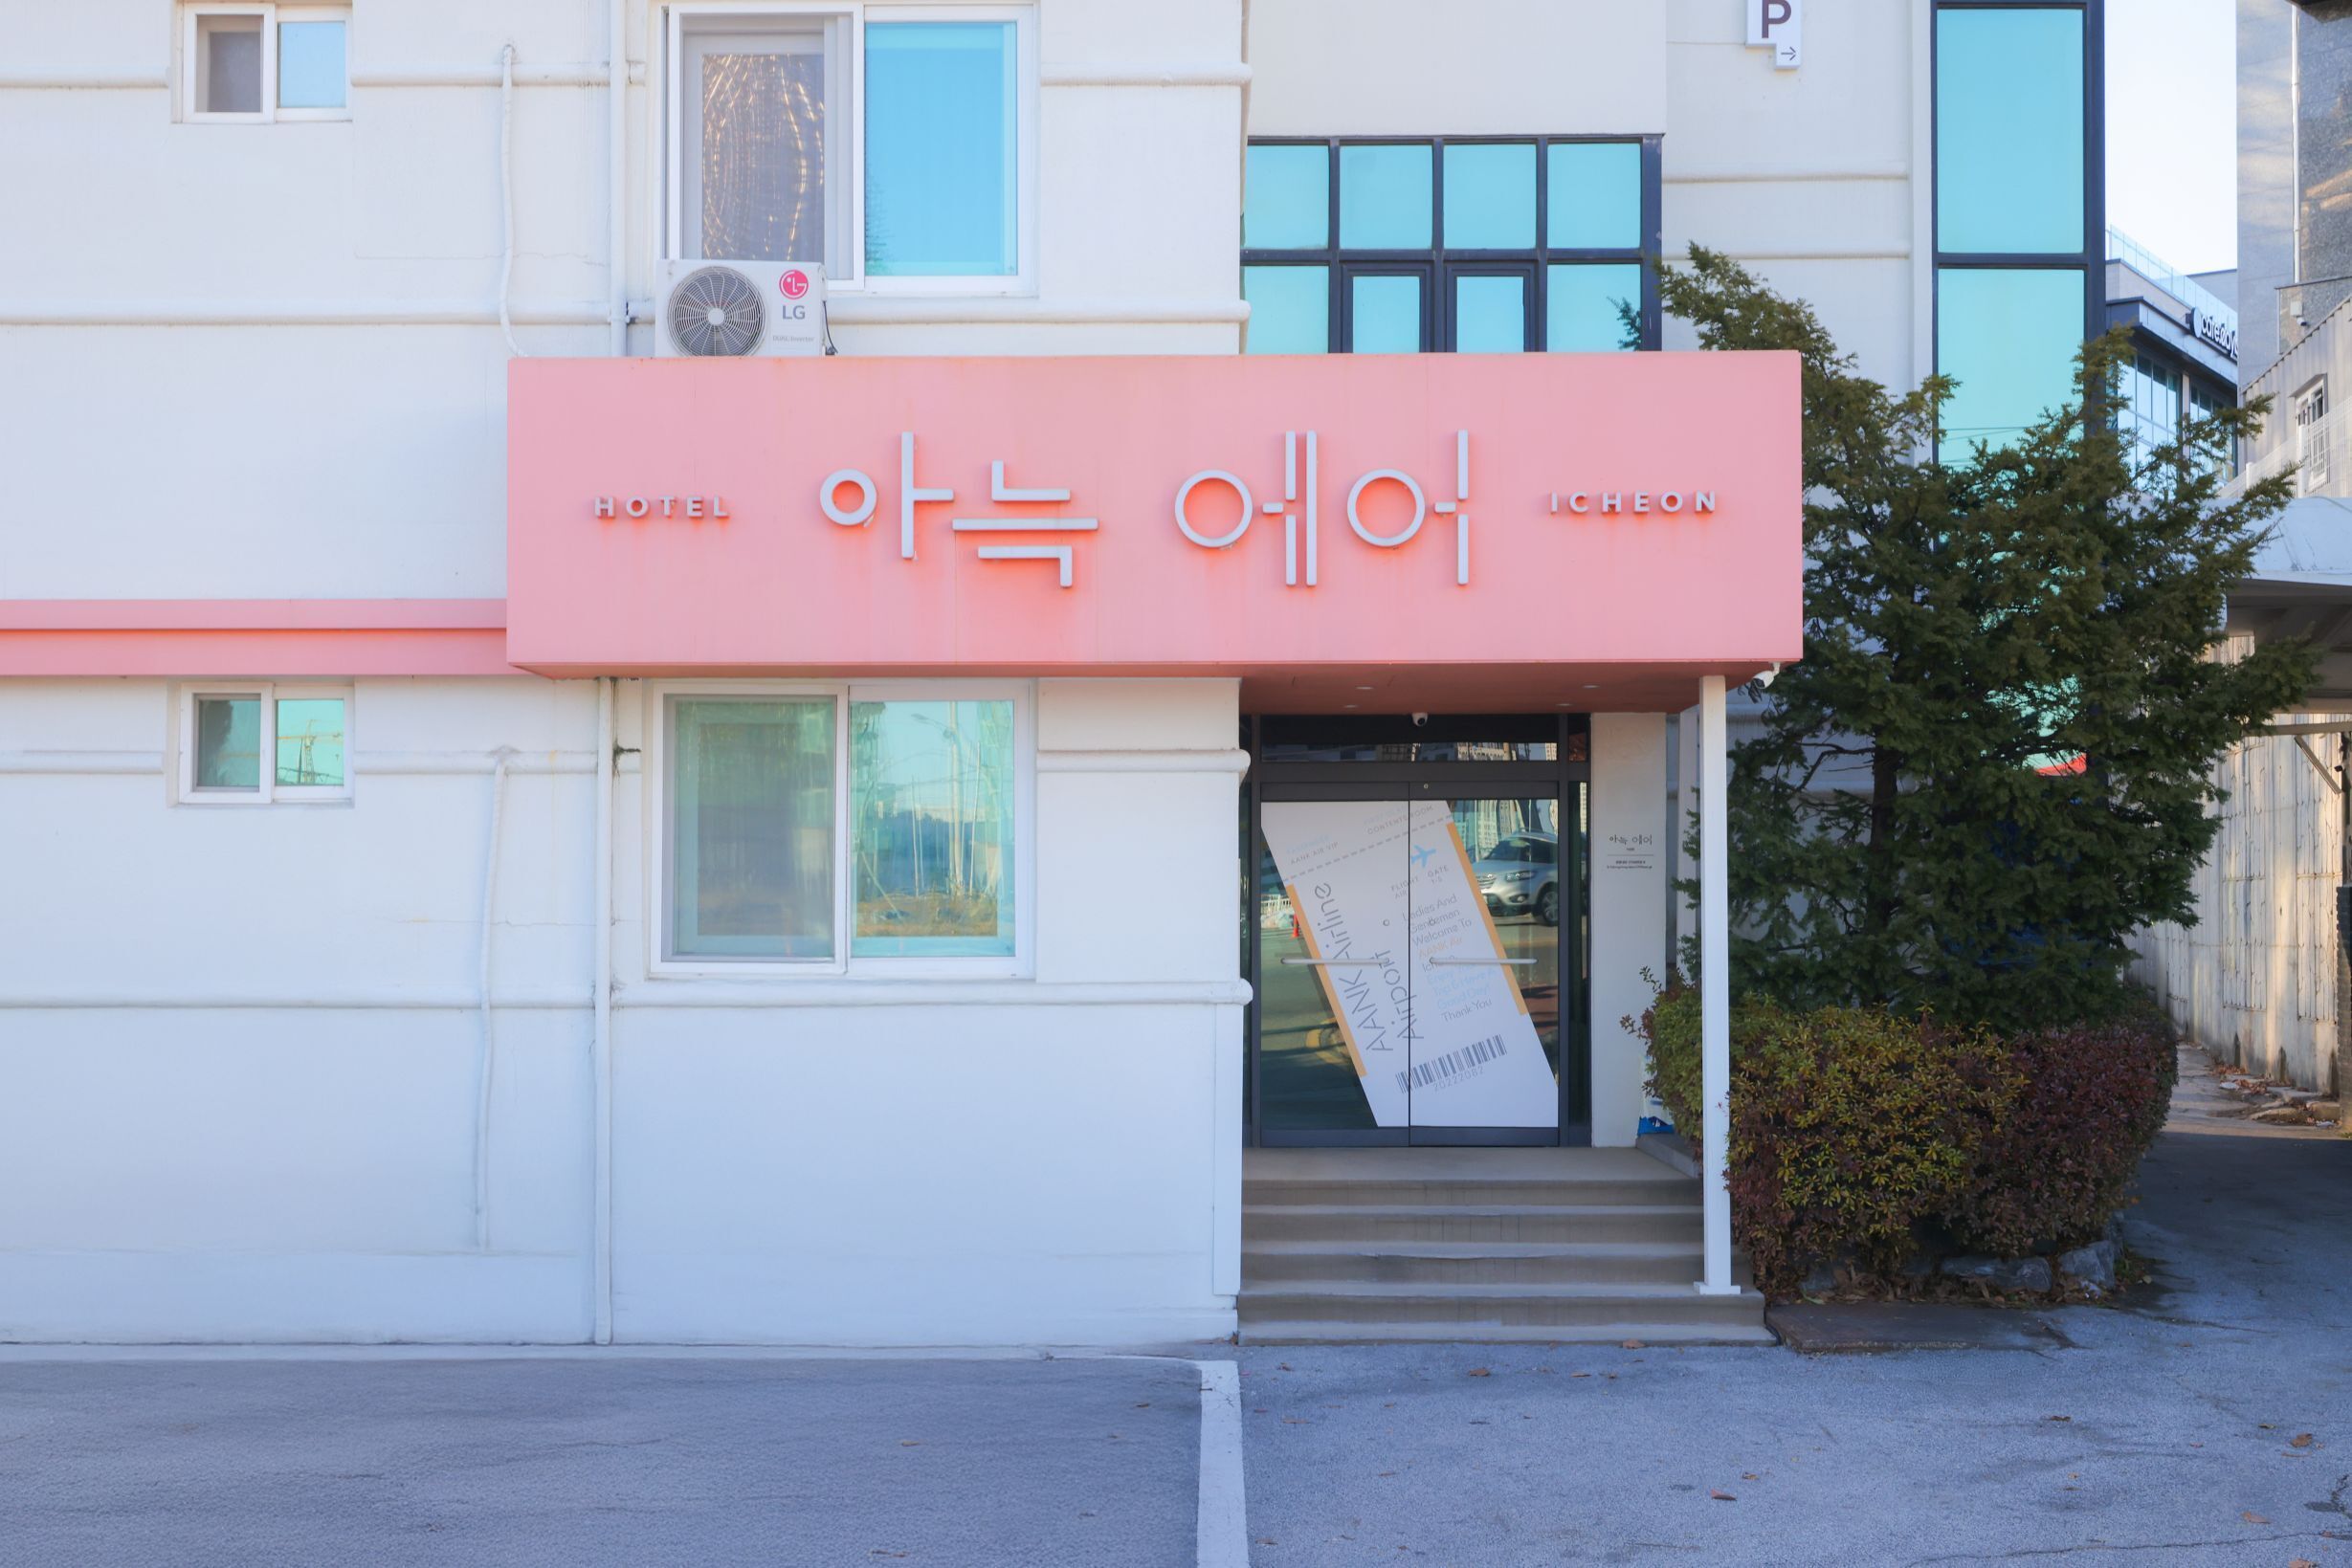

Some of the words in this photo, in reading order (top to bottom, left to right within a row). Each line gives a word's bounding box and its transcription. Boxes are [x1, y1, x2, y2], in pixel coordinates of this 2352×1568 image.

[1762, 0, 1791, 38] P
[782, 305, 806, 320] LG
[594, 496, 730, 519] HOTEL
[820, 431, 1098, 587] 아늑
[1174, 429, 1469, 586] 에어
[1549, 491, 1716, 513] ICHEON
[1402, 903, 1435, 921] Ladies
[1436, 894, 1458, 909] And
[1314, 882, 1355, 964] Airline
[1412, 924, 1458, 946] Welcome
[1457, 917, 1472, 929] To
[1369, 950, 1424, 1039] Airport
[1339, 969, 1393, 1050] AANK
[1441, 1005, 1473, 1023] Thank
[1472, 997, 1493, 1010] You
